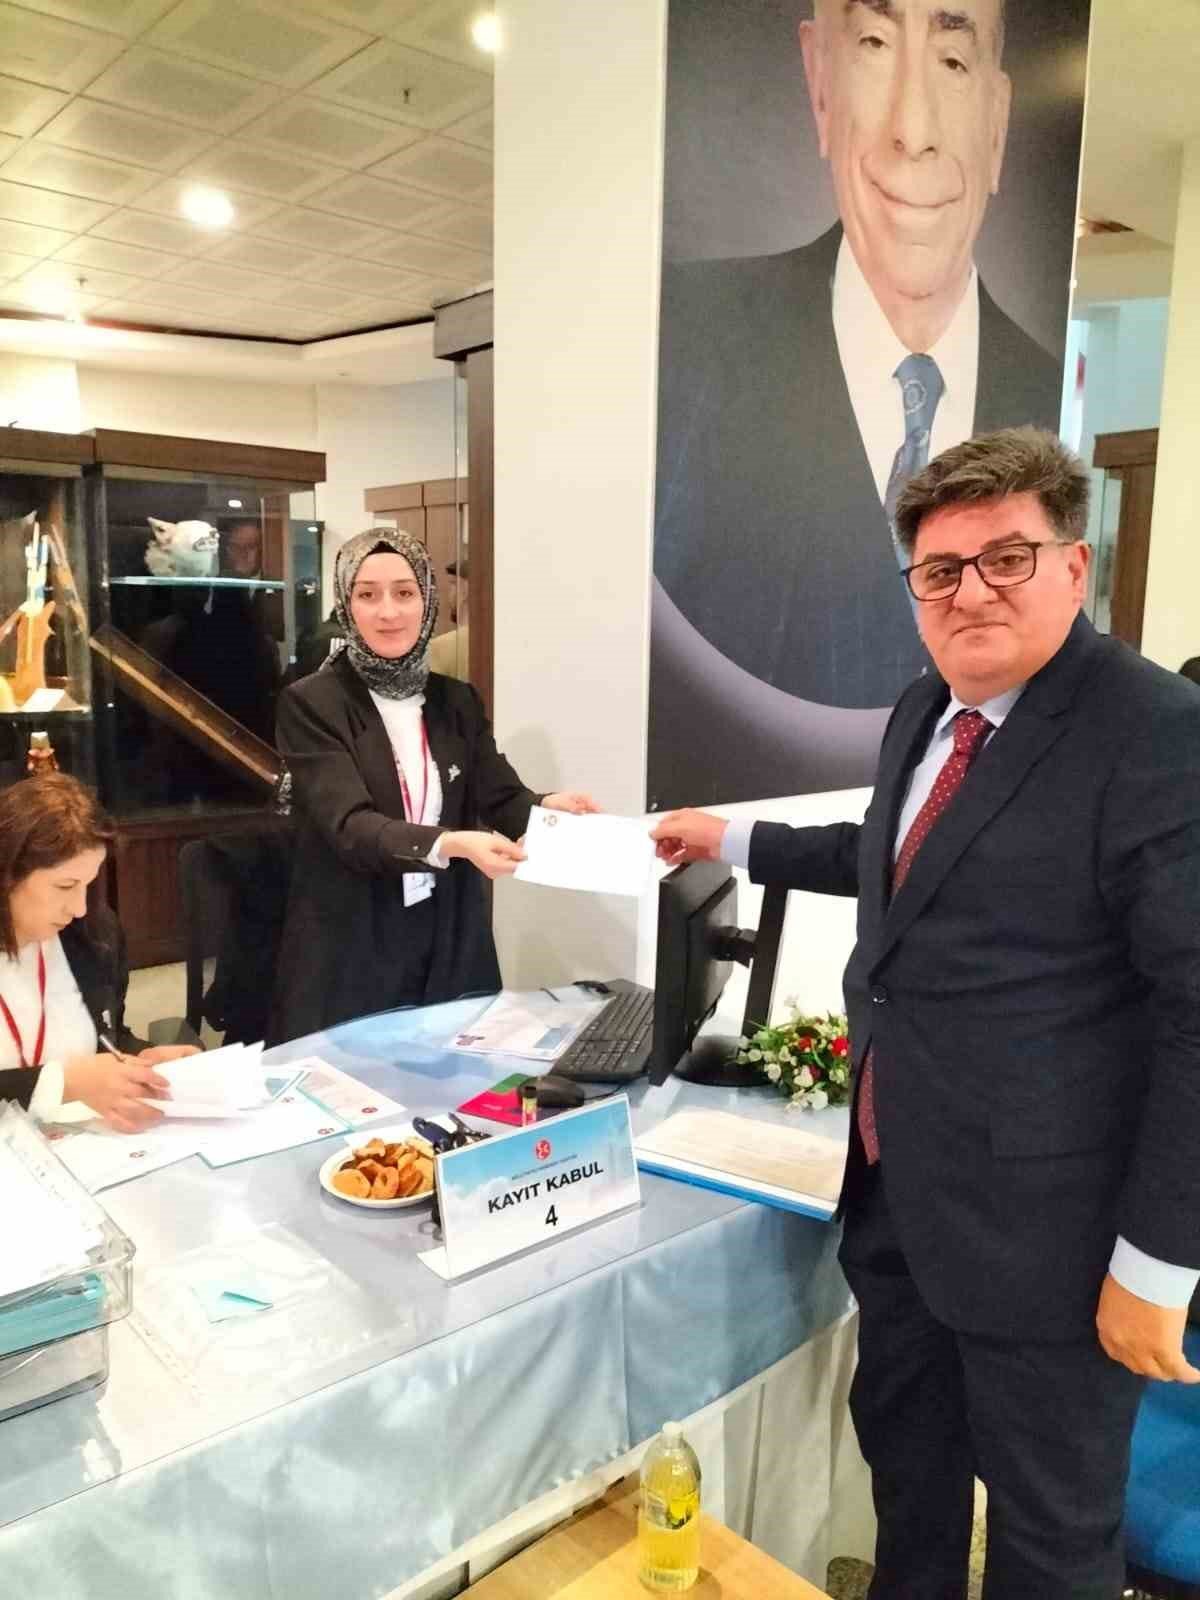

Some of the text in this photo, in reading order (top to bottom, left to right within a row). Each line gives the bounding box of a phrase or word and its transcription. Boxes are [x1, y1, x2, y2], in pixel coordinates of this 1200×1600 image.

[488, 1182, 541, 1214] KAYIT
[546, 1161, 604, 1193] KABUL
[545, 1204, 559, 1226] 4
